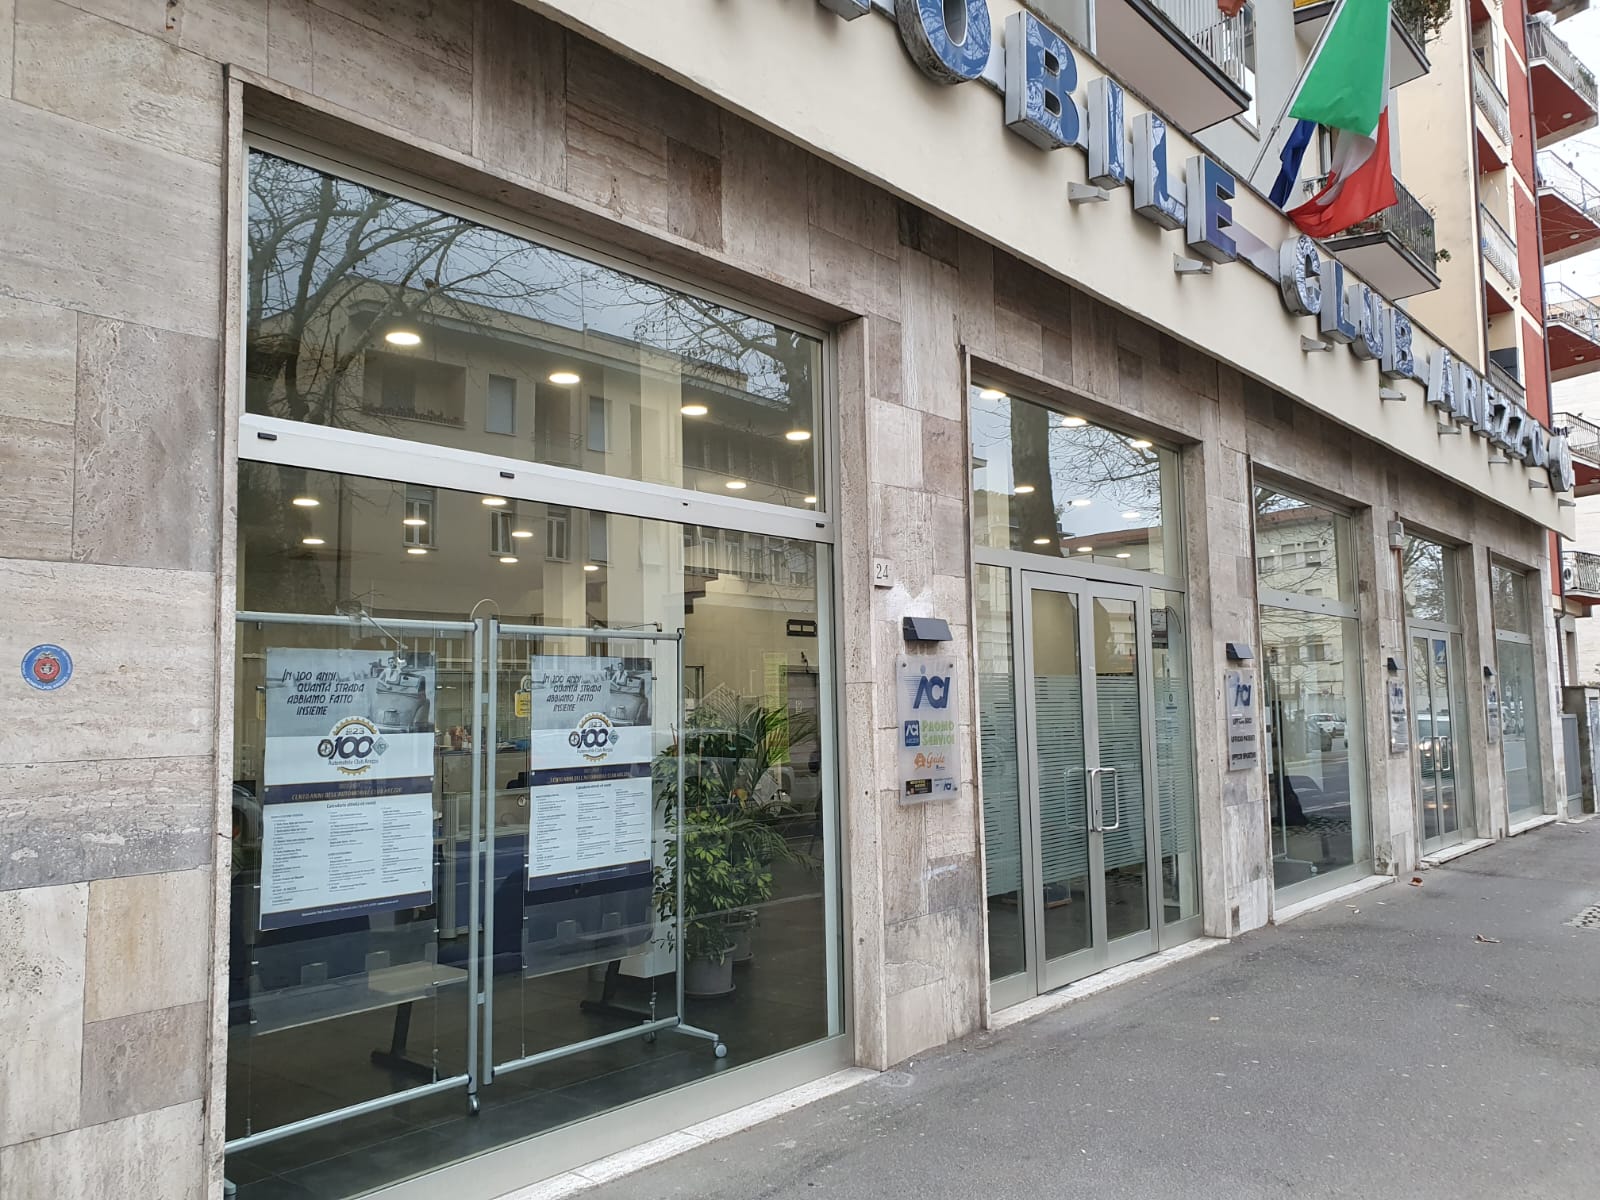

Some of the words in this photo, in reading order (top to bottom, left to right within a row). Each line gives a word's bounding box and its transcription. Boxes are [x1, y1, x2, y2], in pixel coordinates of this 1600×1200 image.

[1280, 234, 1415, 380] CLUB
[1428, 346, 1544, 468] AREZZO
[876, 563, 888, 579] 24
[294, 672, 312, 682] 100
[297, 683, 331, 693] QUANTA
[334, 684, 365, 693] STRADA
[912, 675, 950, 709] ACI
[286, 694, 326, 705] ABBIAMO
[328, 694, 354, 704] FATTO
[546, 694, 574, 702] ABBIAMO
[576, 694, 594, 702] FATTO
[296, 706, 329, 716] INSIEME
[552, 704, 576, 712] INSIEME
[328, 736, 374, 760] 100
